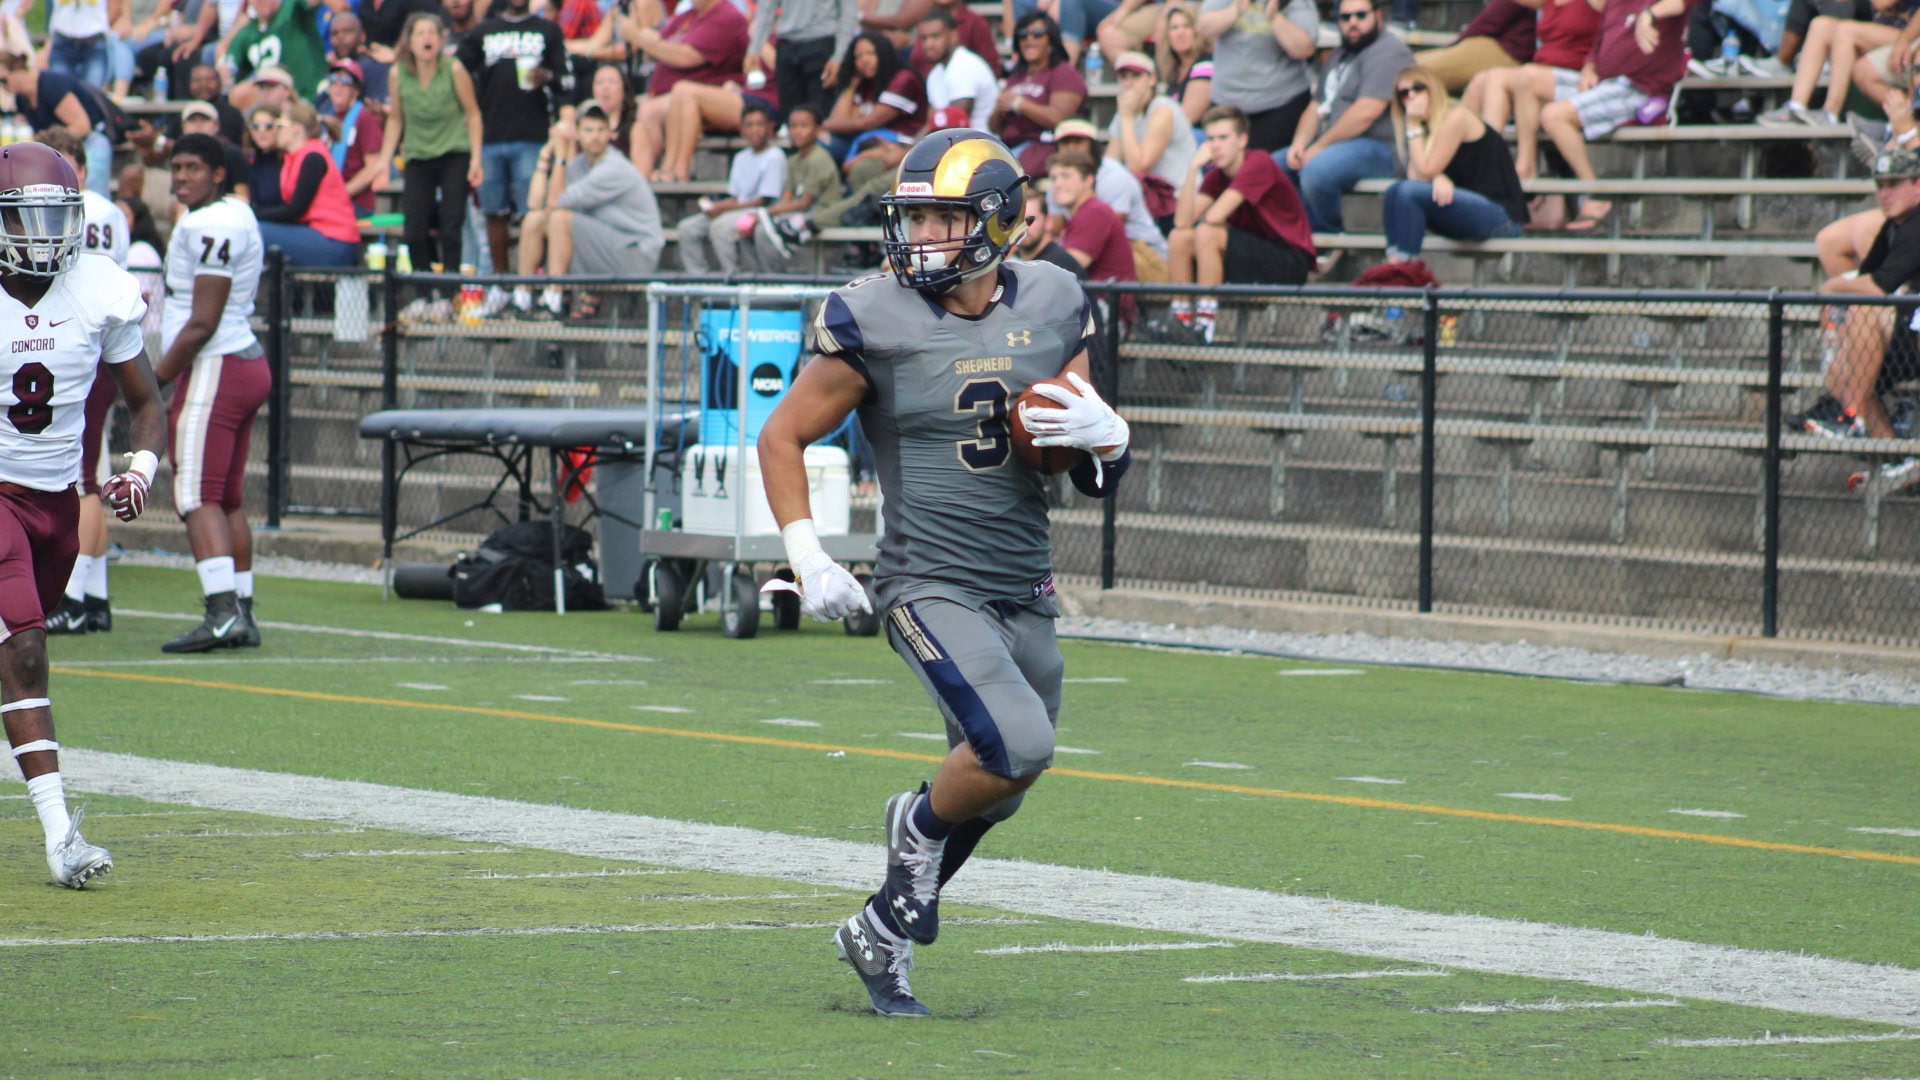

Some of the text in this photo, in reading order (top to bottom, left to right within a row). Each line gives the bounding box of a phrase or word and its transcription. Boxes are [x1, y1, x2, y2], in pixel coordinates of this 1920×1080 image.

[900, 185, 927, 193] Riddell
[87, 224, 112, 249] 69
[201, 236, 231, 265] 74
[12, 338, 55, 353] CONCORD
[954, 357, 1012, 374] SHEPHERD
[752, 377, 785, 392] NCAA
[7, 362, 55, 434] 8
[954, 377, 1012, 473] 3
